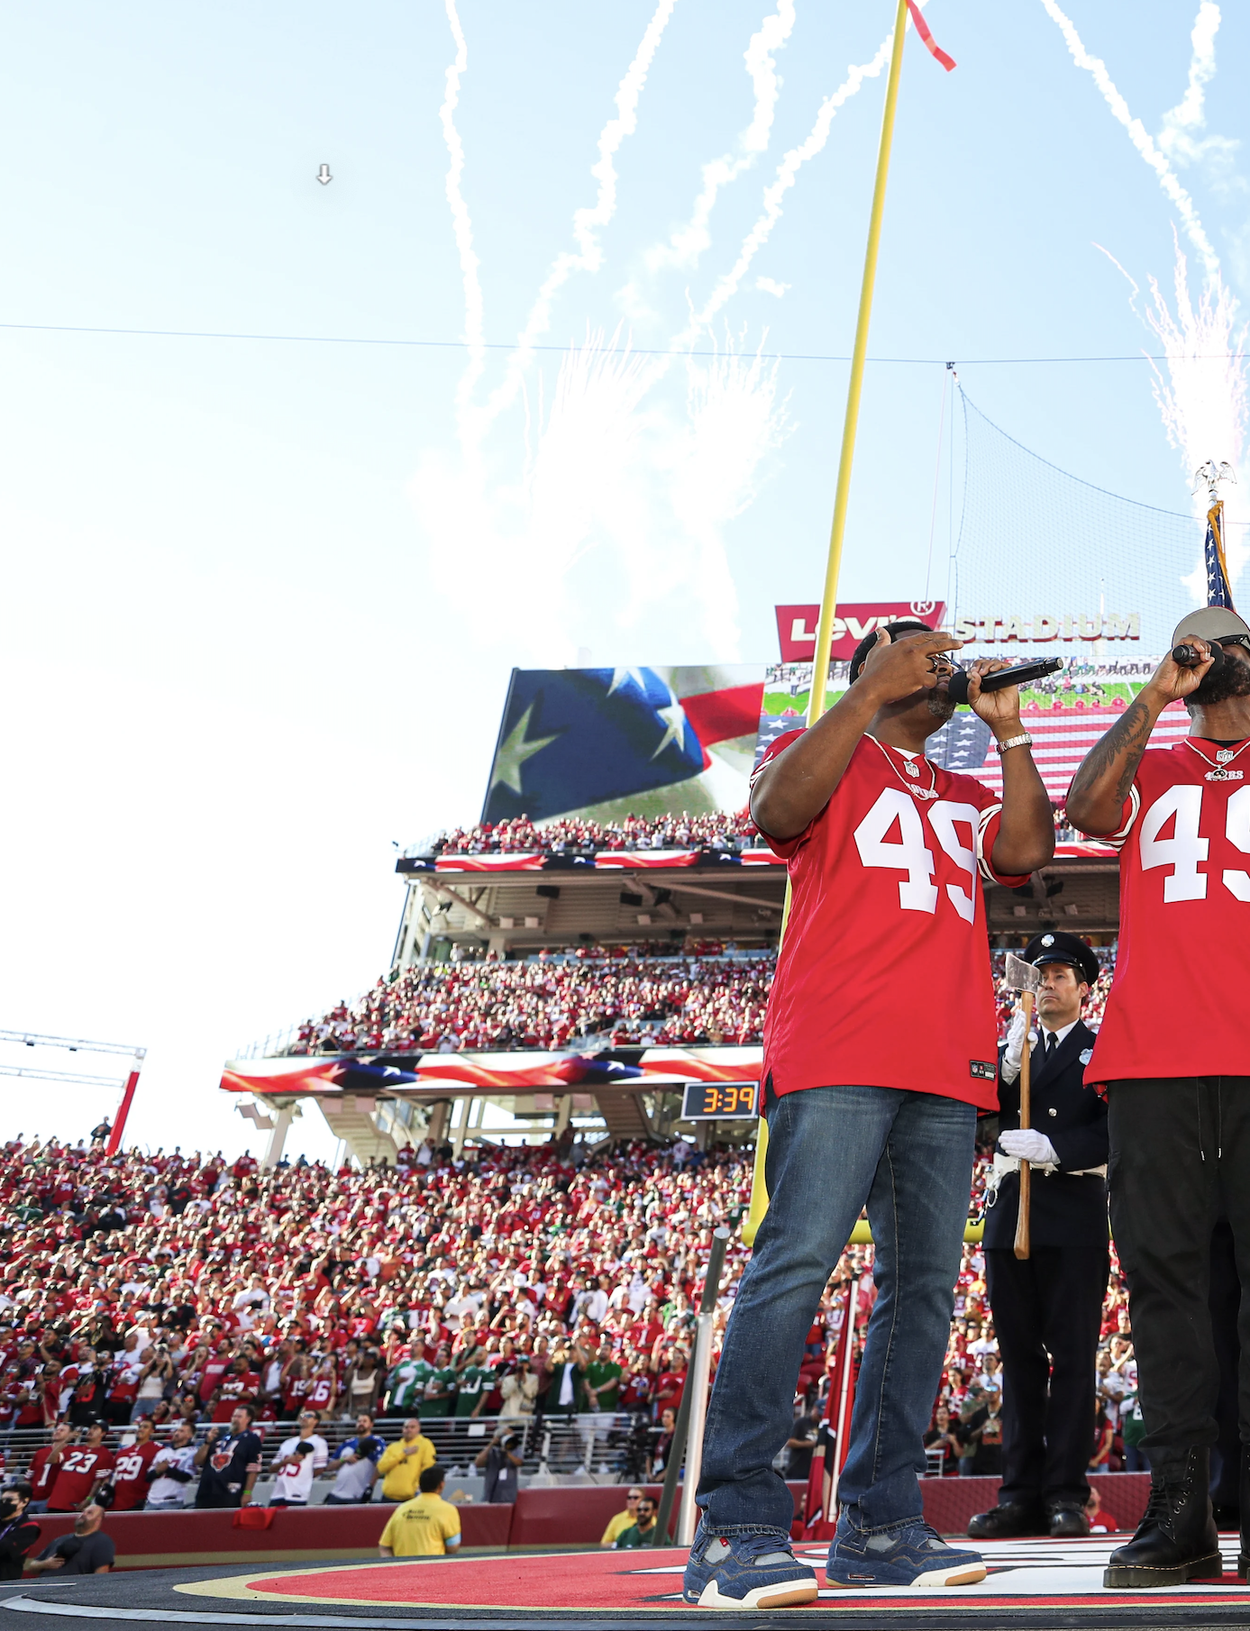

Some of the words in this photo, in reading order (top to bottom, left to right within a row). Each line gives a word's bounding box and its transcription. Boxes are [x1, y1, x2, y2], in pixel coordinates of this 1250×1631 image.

[957, 613, 1140, 644] STADIUM
[853, 786, 980, 926] 49
[703, 1087, 755, 1113] 3:39
[37, 1463, 51, 1487] 1
[62, 1451, 97, 1474] 23
[115, 1456, 143, 1481] 29
